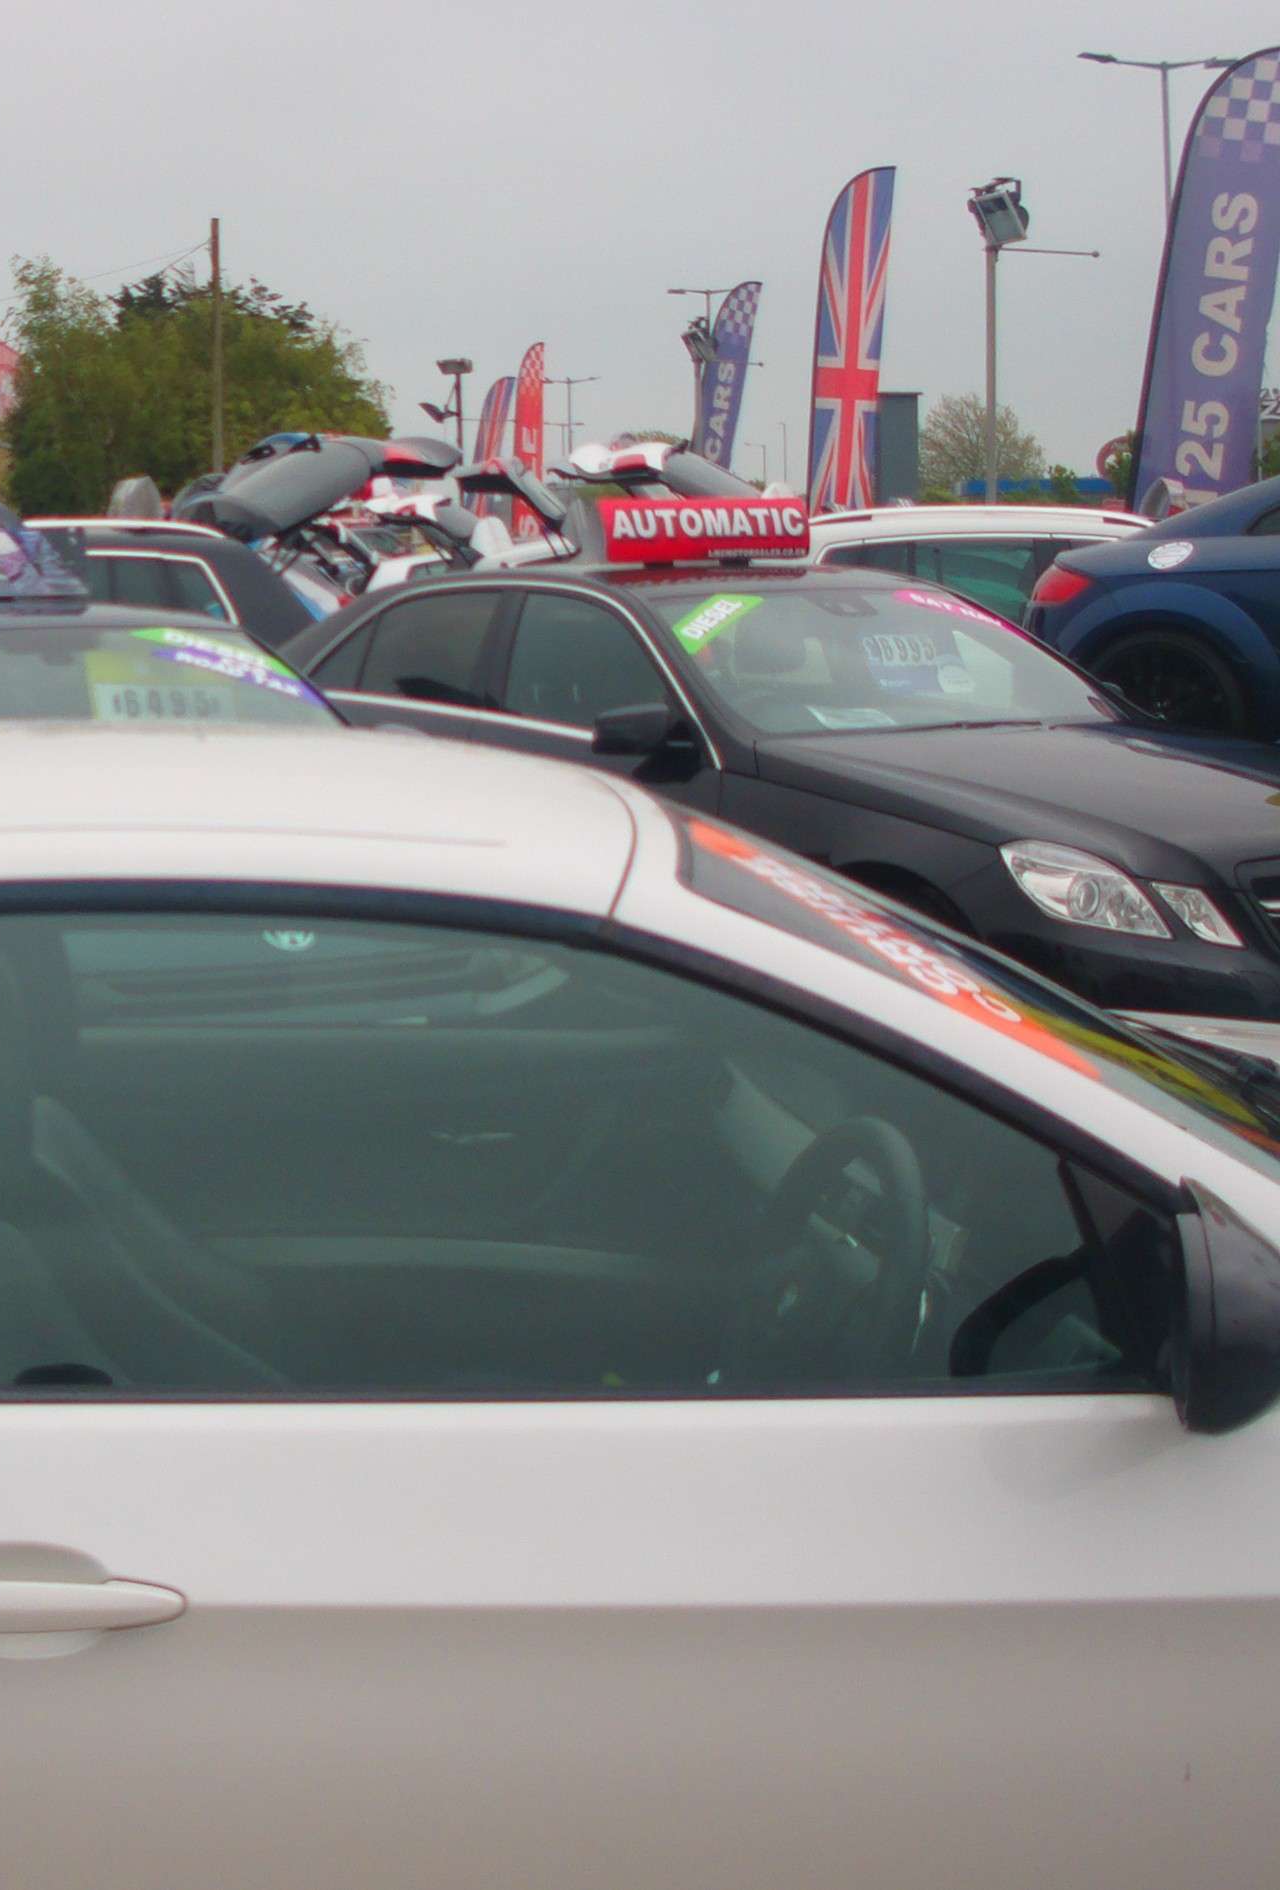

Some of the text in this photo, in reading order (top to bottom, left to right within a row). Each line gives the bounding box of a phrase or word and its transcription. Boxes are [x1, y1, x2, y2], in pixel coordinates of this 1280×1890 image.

[1191, 192, 1260, 377] CARS
[704, 362, 737, 461] CARS
[612, 506, 805, 538] AUTOMATIC
[681, 599, 744, 640] DIESEL
